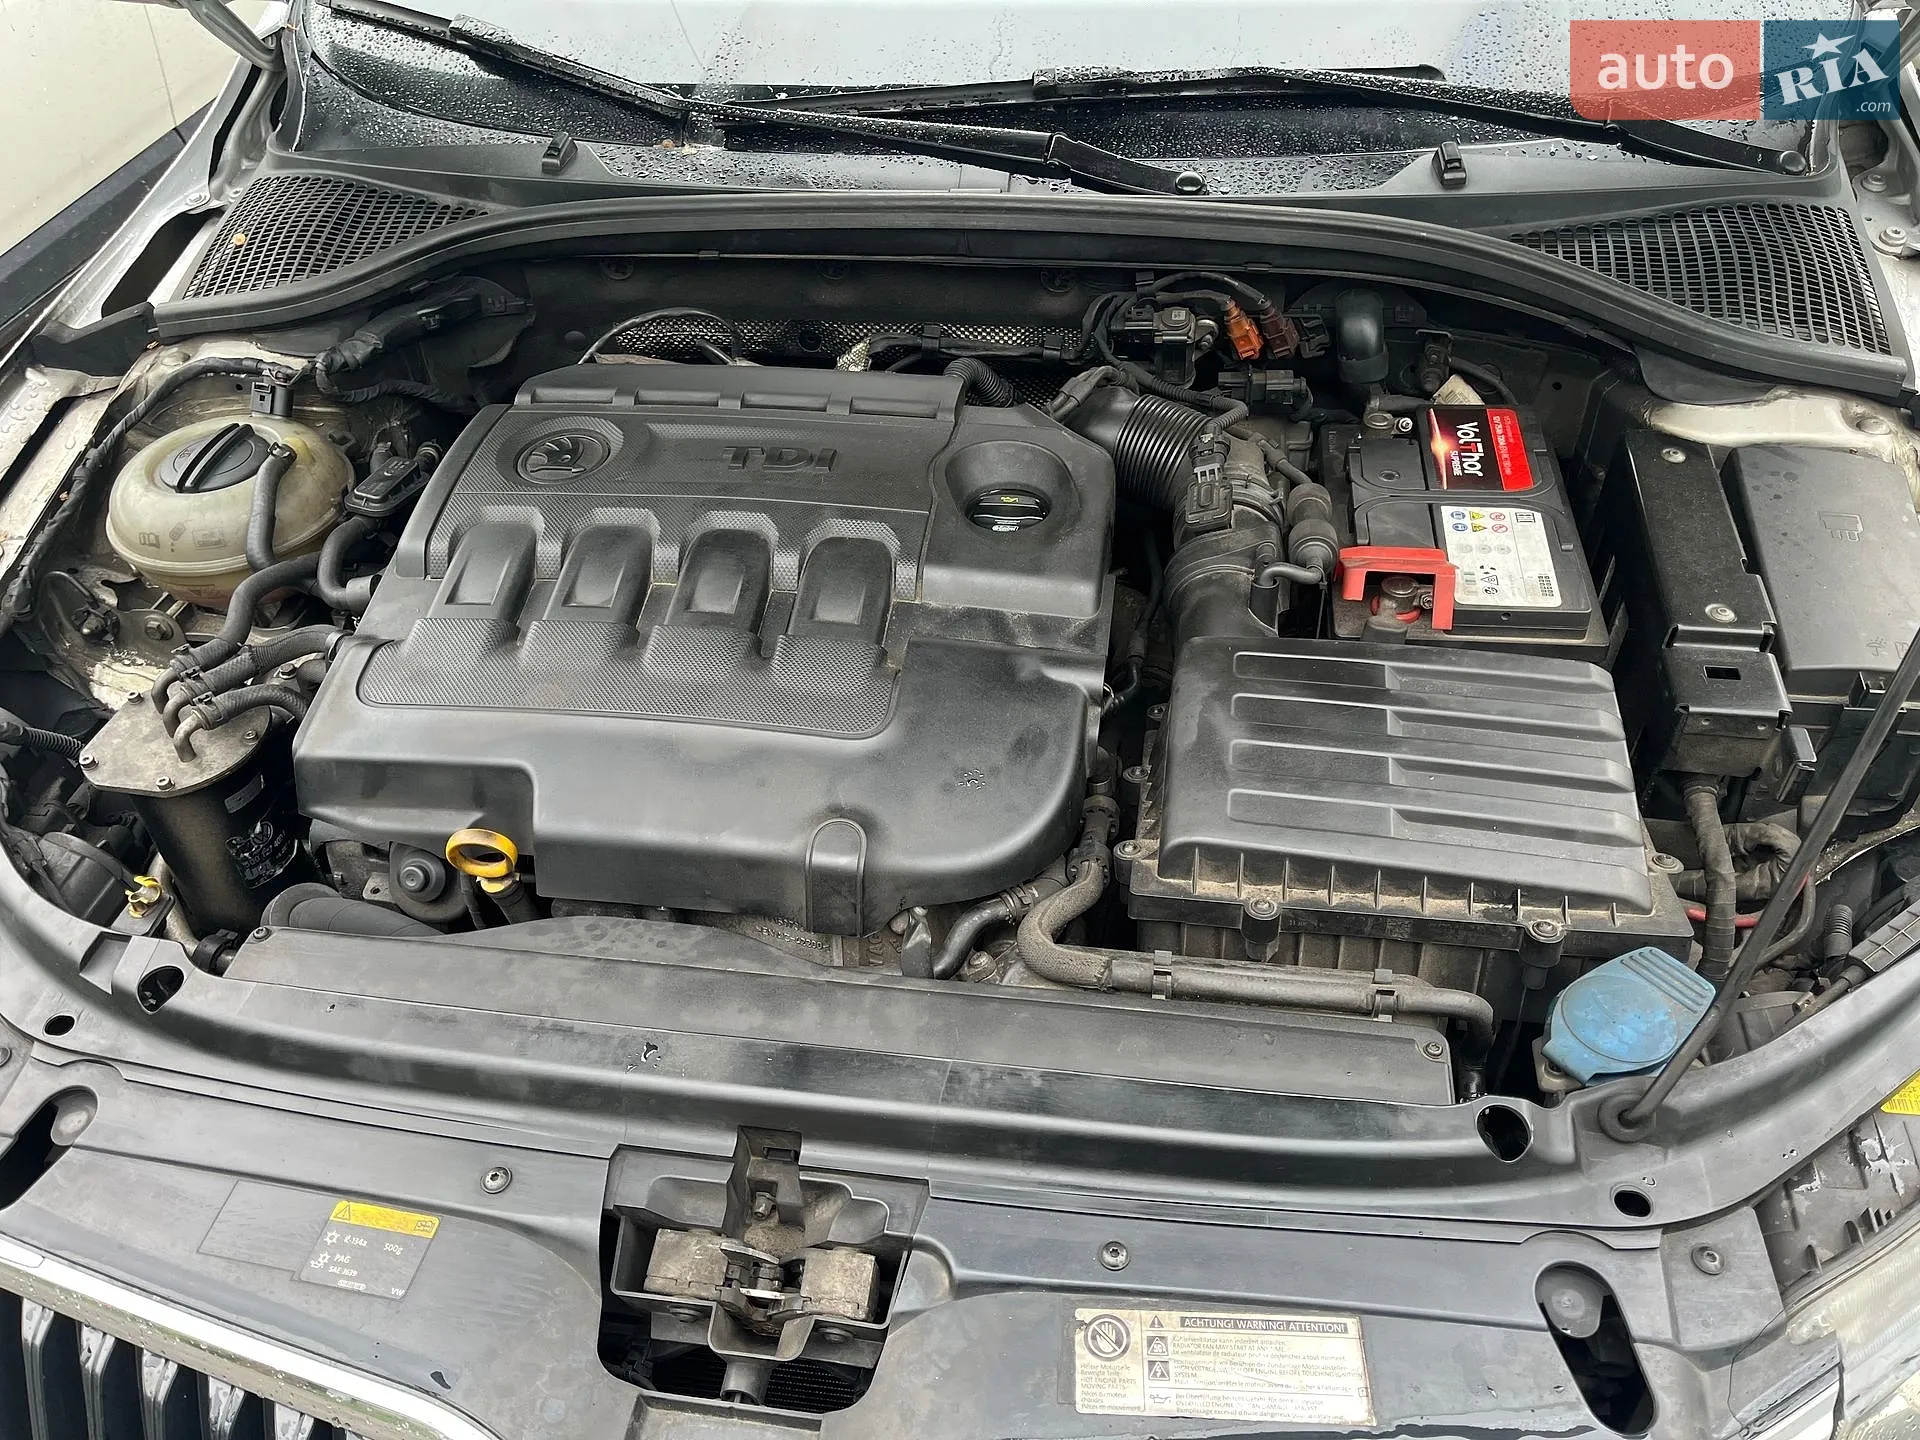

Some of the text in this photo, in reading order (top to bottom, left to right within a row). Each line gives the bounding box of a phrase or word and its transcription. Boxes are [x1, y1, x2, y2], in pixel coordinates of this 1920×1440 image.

[1456, 422, 1485, 477] VolThor
[720, 445, 839, 473] TDI
[1449, 449, 1463, 477] SUPREME
[383, 1242, 404, 1256] 500g
[334, 1253, 352, 1264] PAG
[328, 1265, 342, 1275] SAE
[391, 1287, 406, 1296] VW
[1184, 1318, 1345, 1333] ACHTUNG! WARNING! ATTENTION!
